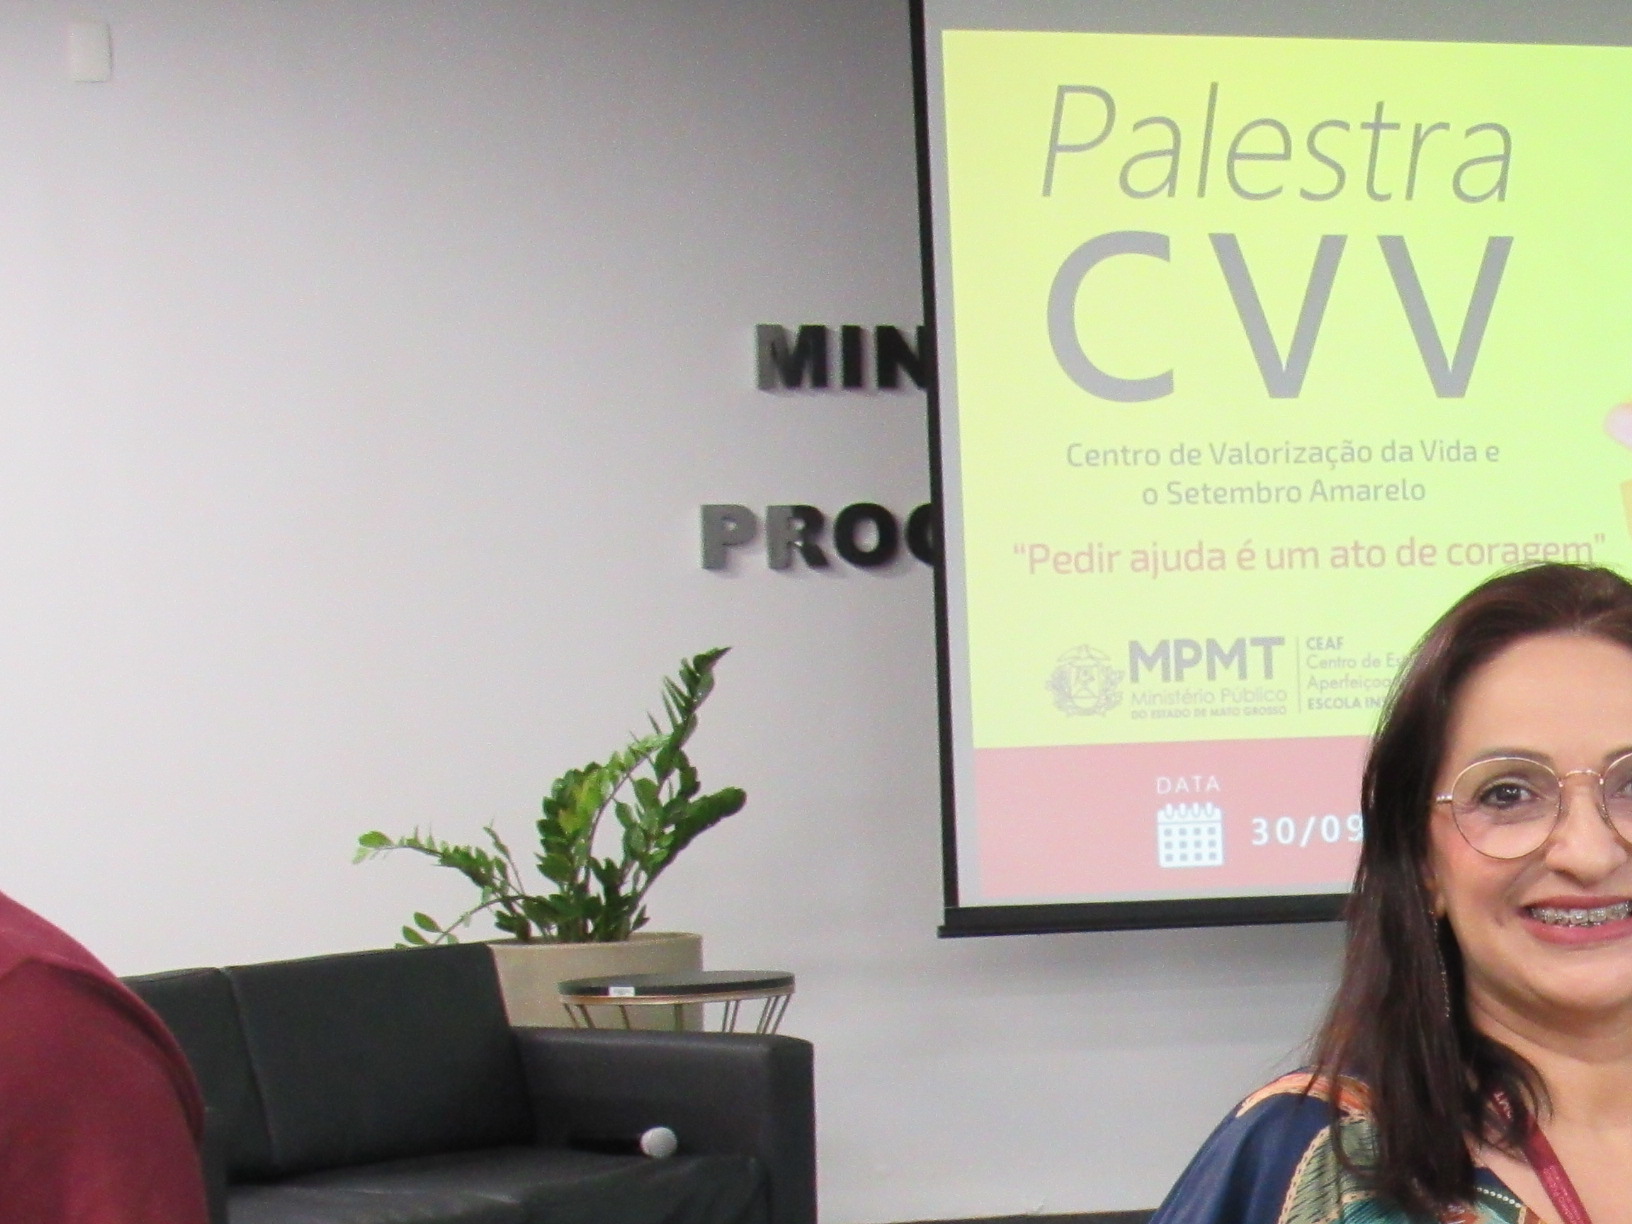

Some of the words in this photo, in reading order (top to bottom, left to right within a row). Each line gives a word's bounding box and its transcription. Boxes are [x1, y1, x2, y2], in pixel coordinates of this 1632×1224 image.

[1041, 81, 1513, 204] Palestra
[1046, 229, 1515, 403] CVV
[1066, 442, 1161, 468] Centro
[1169, 442, 1202, 466] de
[1208, 439, 1373, 470] Valorização
[1381, 440, 1414, 464] da
[1420, 439, 1478, 463] Vida
[1485, 447, 1500, 463] e
[1142, 486, 1158, 506] o
[1166, 480, 1302, 506] Setembro
[1309, 478, 1426, 503] Amarelo
[1130, 540, 1227, 580] ajuda
[1236, 538, 1256, 572] é
[1265, 545, 1320, 571] um
[1330, 539, 1386, 569] ato
[1395, 536, 1438, 567] de
[1306, 636, 1344, 651] CEAF
[1128, 636, 1286, 684] MPMT
[1306, 653, 1357, 670] Centro
[1362, 653, 1381, 668] de
[1131, 690, 1216, 705] Ministério
[1221, 687, 1288, 702] Público
[1156, 776, 1221, 795] DATA
